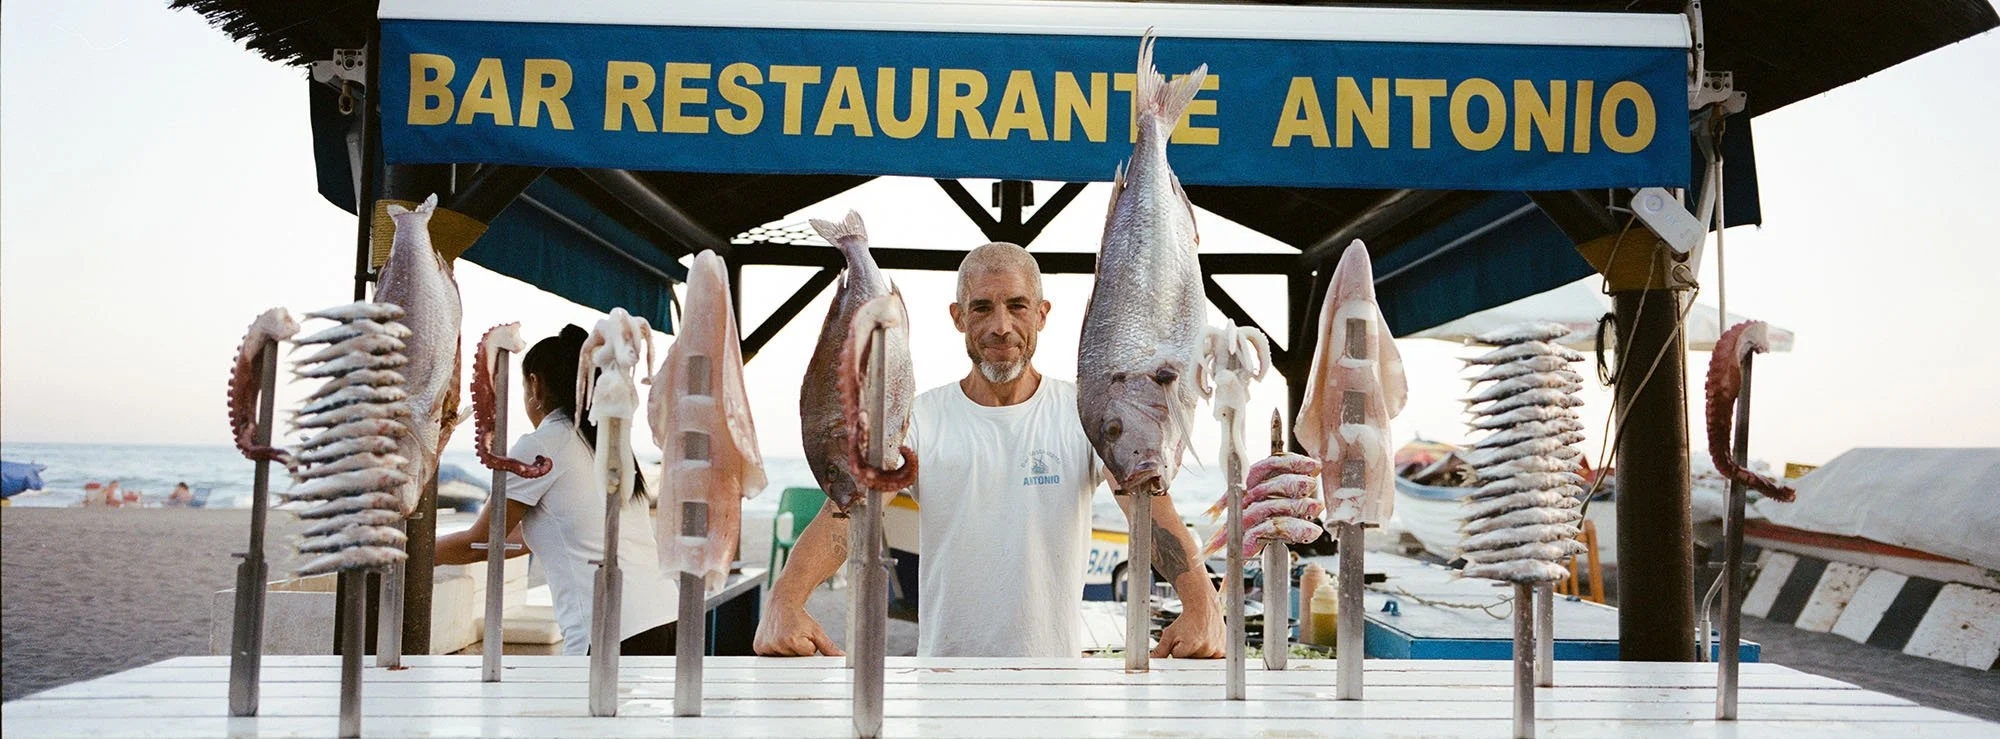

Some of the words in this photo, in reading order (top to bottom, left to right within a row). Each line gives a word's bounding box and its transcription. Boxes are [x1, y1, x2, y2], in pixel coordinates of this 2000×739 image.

[408, 54, 573, 130] BAR
[1273, 77, 1657, 153] ANTONIO
[1023, 474, 1060, 486] ANTONIO
